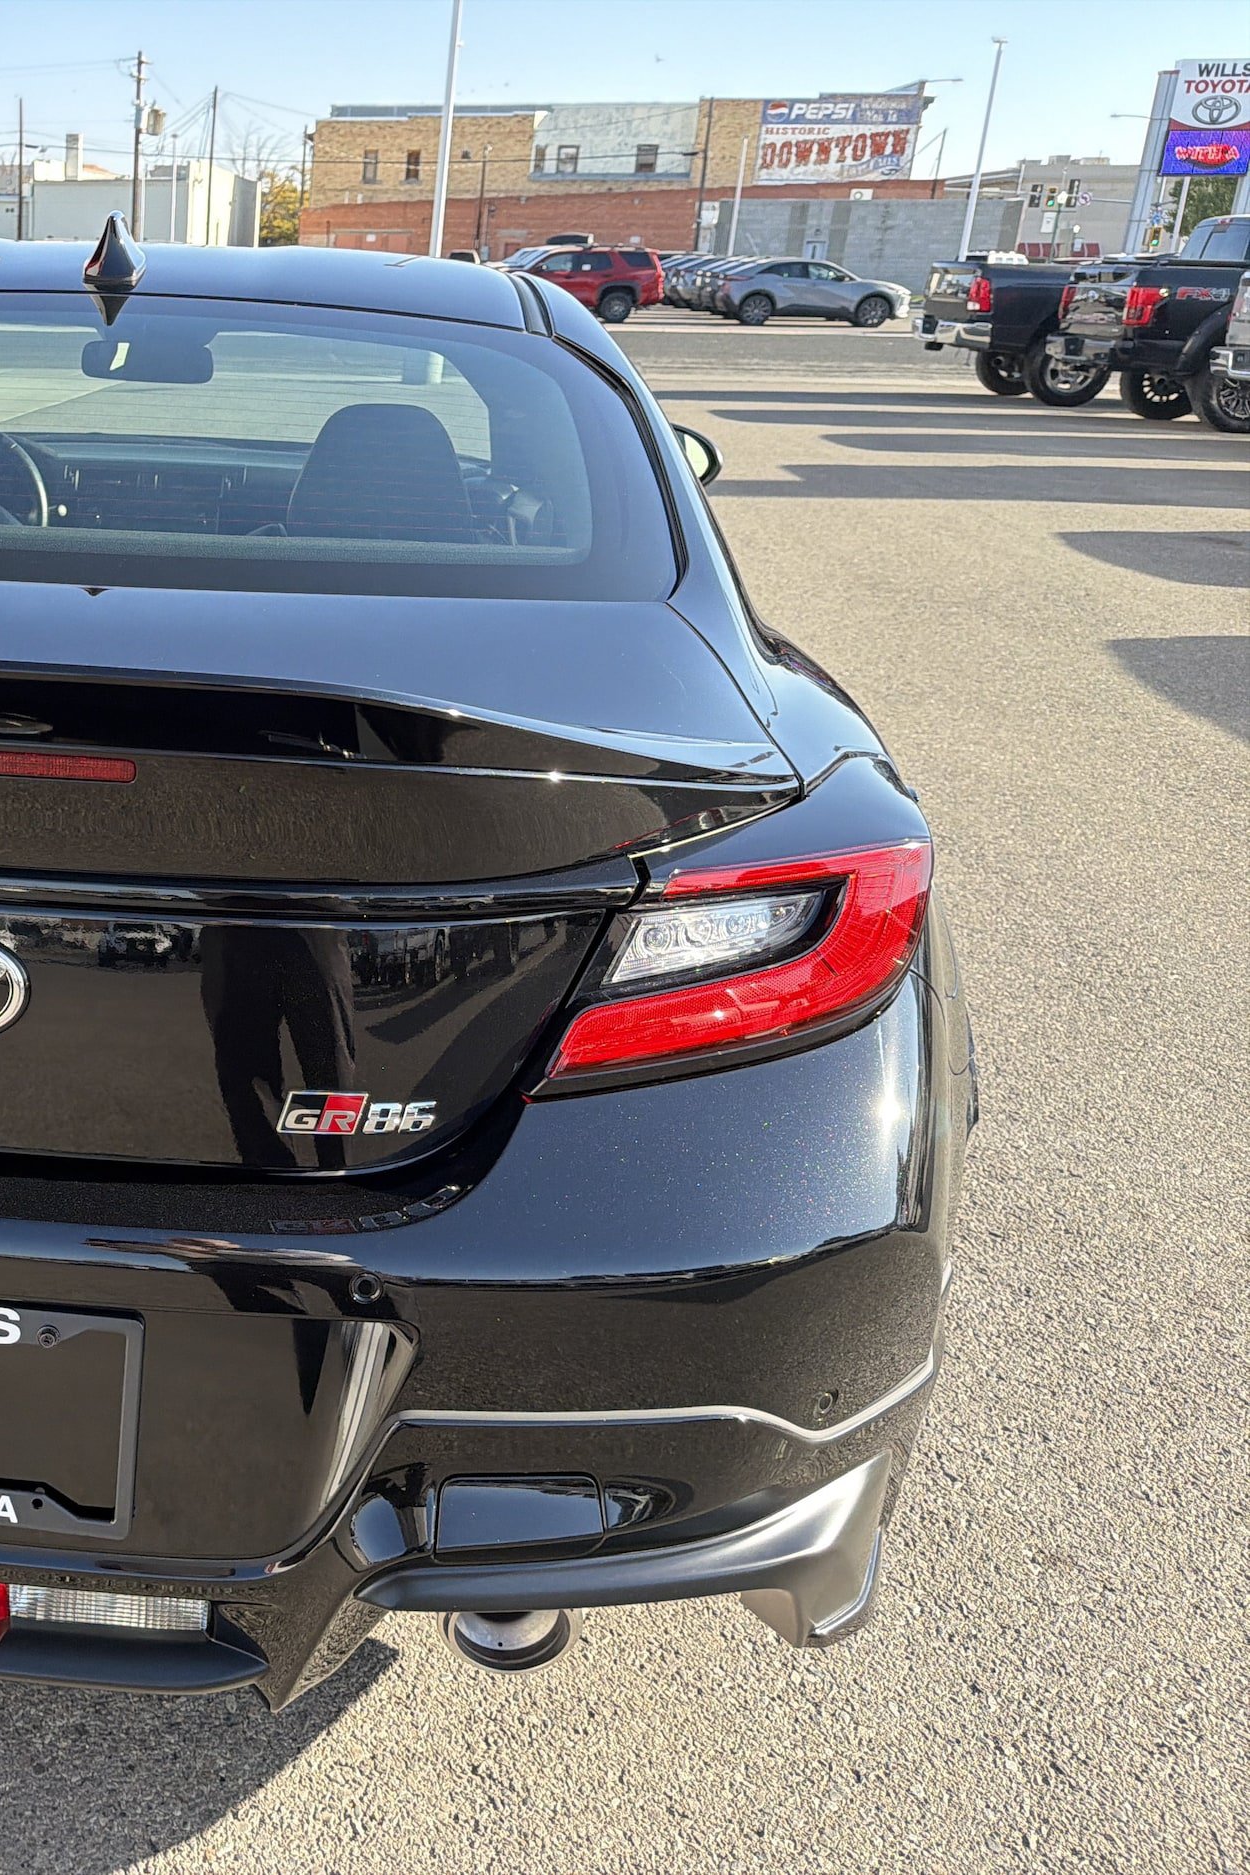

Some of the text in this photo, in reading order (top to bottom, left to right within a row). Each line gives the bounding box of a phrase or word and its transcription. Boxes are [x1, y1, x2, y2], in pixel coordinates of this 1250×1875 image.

[1198, 63, 1250, 77] WILLS
[790, 103, 856, 120] PEPSI
[765, 127, 830, 135] HISTORIC
[760, 128, 910, 169] DOWNTOWN
[1176, 286, 1230, 302] FX4
